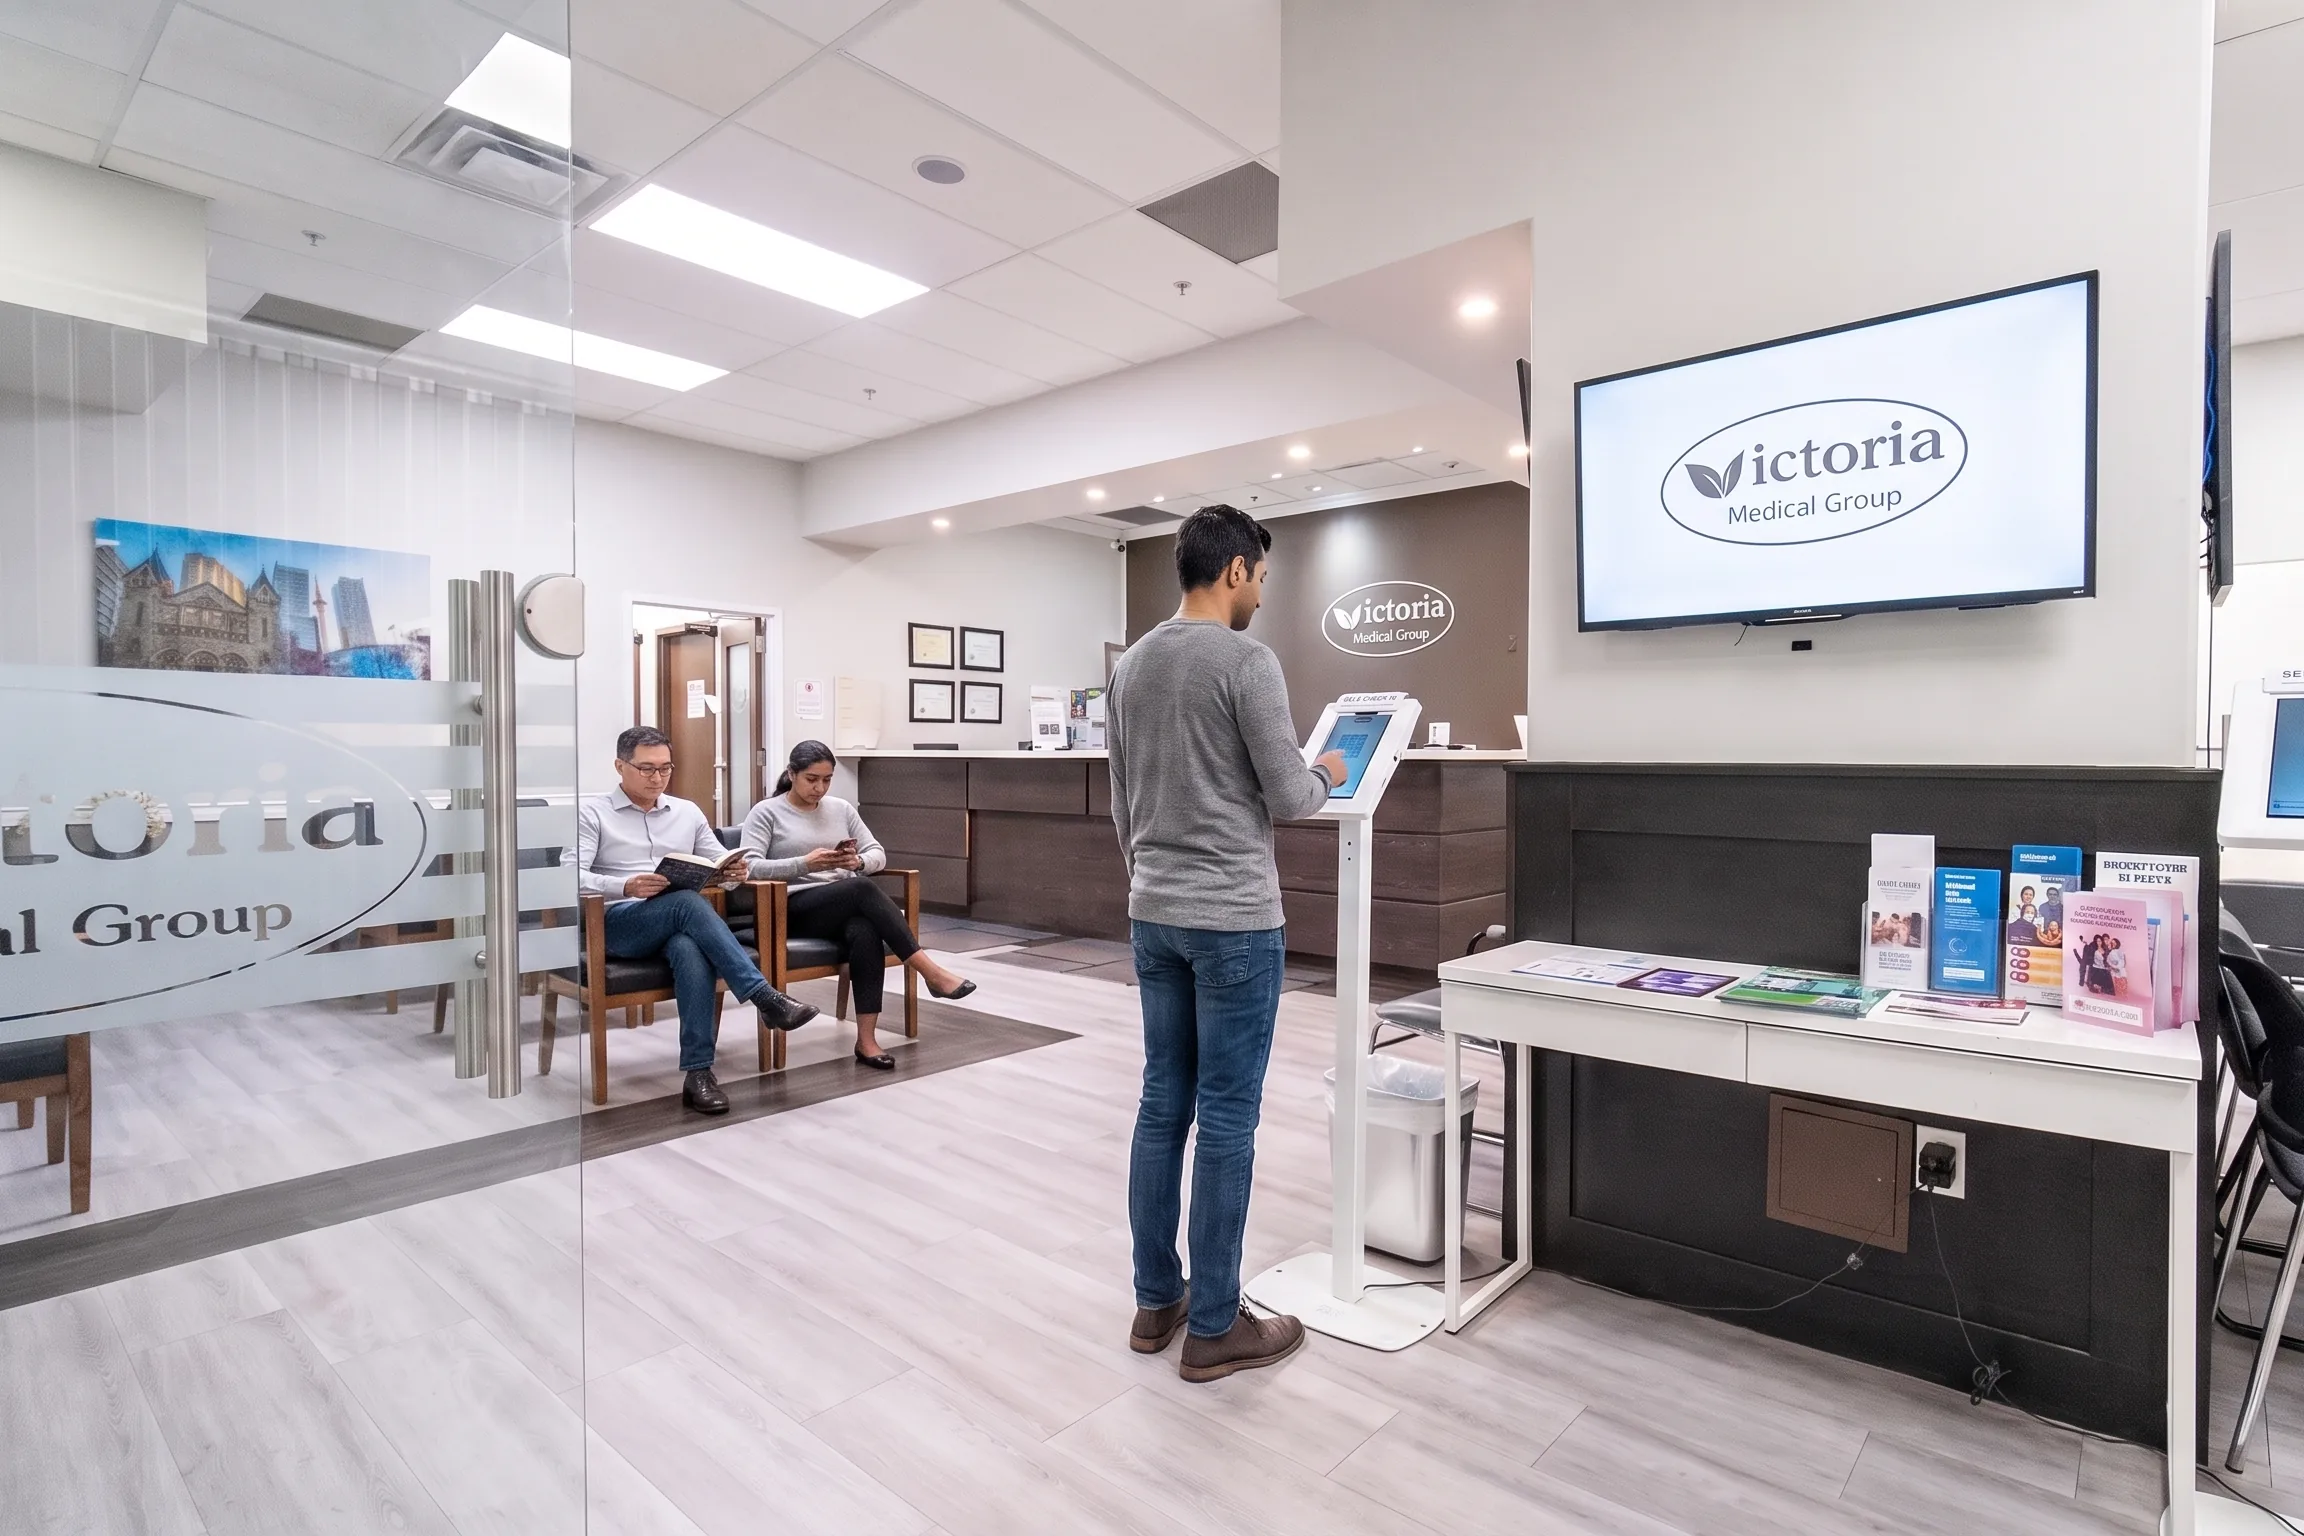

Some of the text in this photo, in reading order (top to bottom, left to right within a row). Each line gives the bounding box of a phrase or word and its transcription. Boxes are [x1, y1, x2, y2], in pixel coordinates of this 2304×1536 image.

[1728, 486, 1902, 525] Medical Group
[1353, 628, 1430, 644] Medical Group
[2282, 670, 2304, 679] SE
[73, 903, 293, 947] Group
